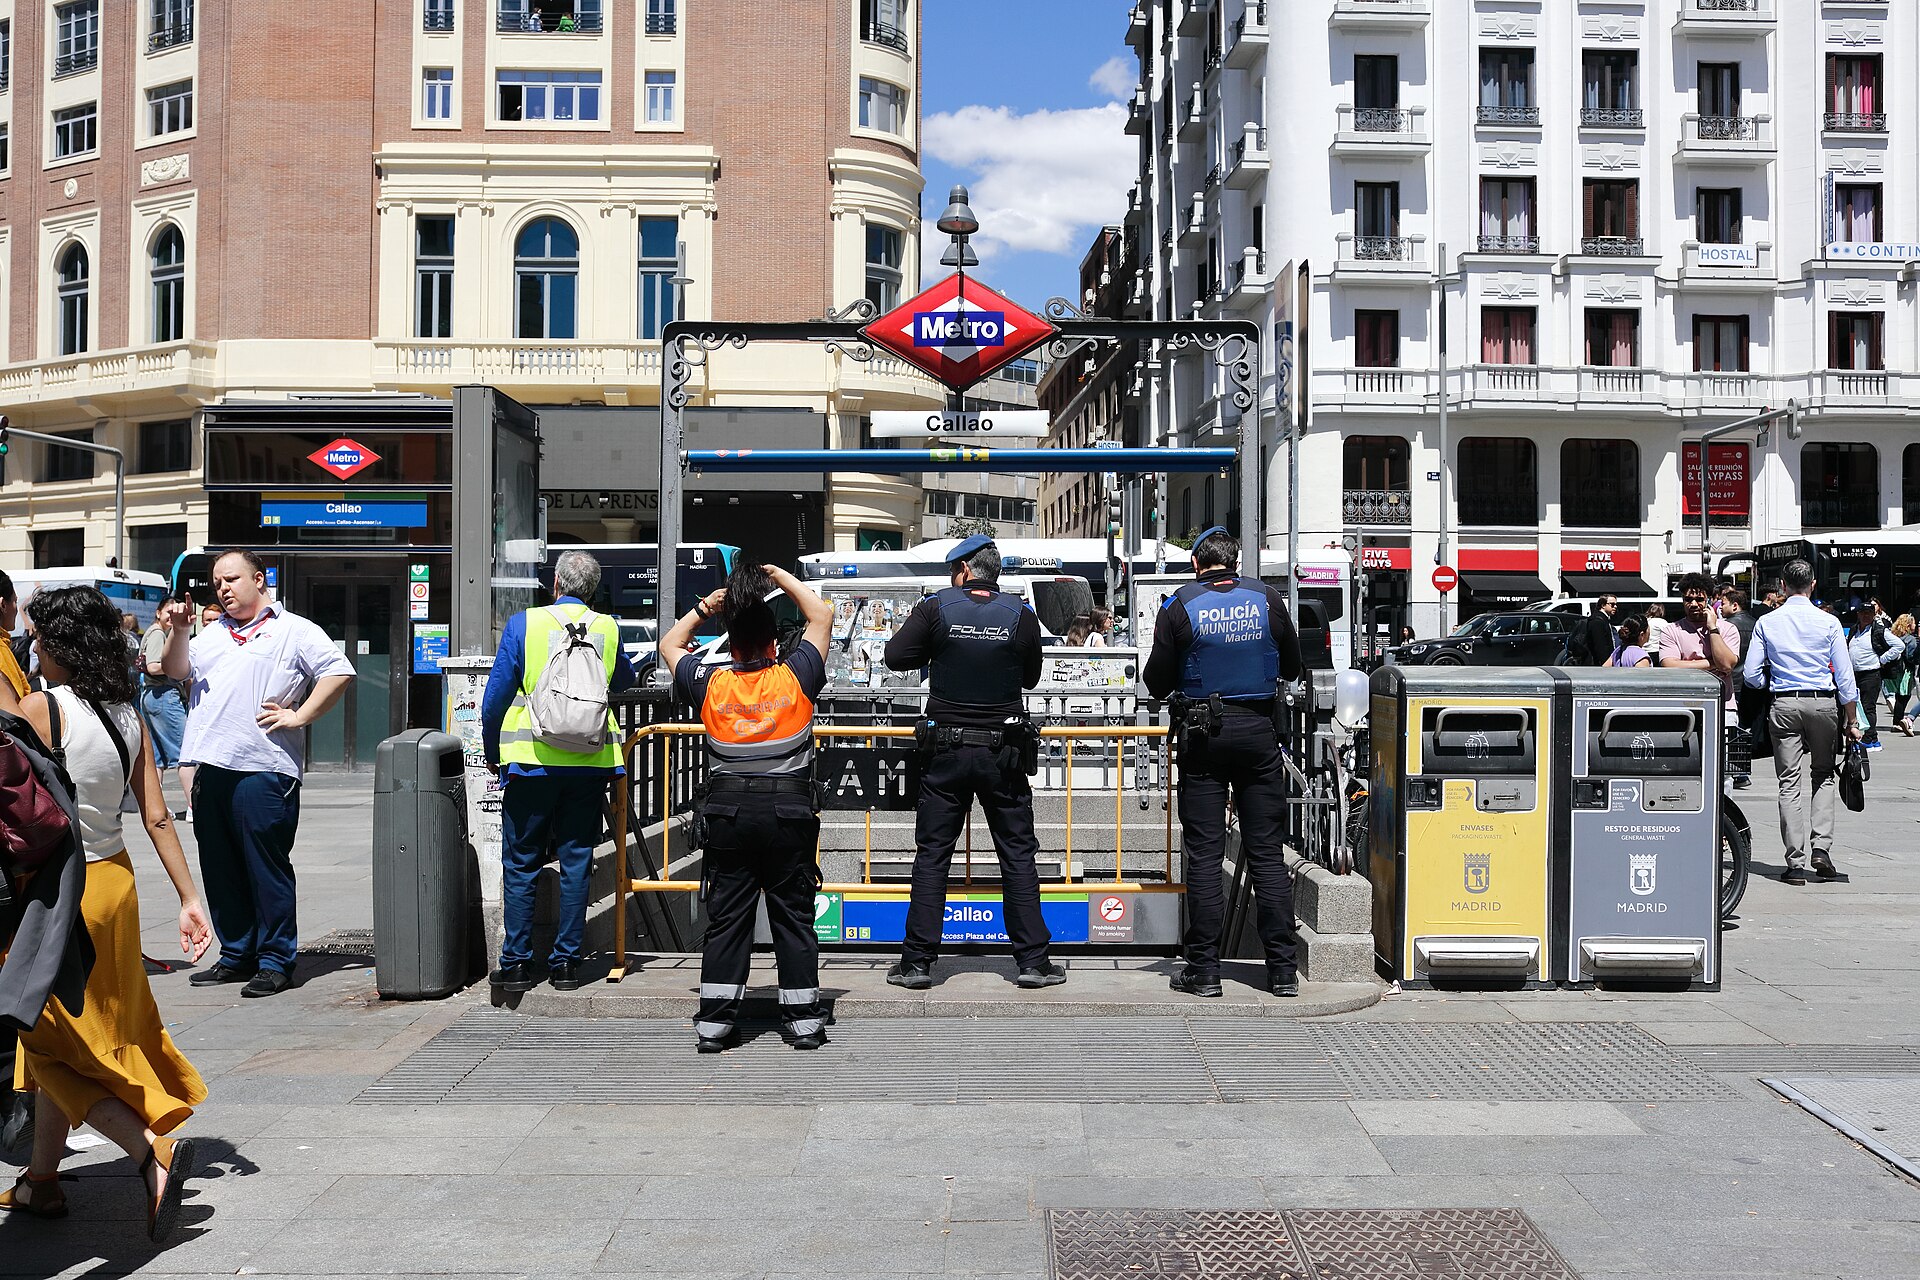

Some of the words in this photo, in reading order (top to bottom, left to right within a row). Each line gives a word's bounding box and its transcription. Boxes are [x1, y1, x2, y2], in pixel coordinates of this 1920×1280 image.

[1701, 249, 1753, 261] HOSTAL
[921, 317, 998, 339] Metro
[926, 415, 994, 431] Callao
[330, 453, 359, 463] Metro
[1714, 462, 1743, 471] REUNIÓN
[1687, 472, 1694, 480] &
[570, 494, 594, 509] LA
[326, 503, 362, 513] Callao
[1364, 550, 1389, 558] FIVE
[1587, 553, 1612, 561] FIVE
[1763, 546, 1770, 560] 74
[1022, 557, 1057, 566] POLICIA
[1362, 559, 1392, 567] GUYS
[1585, 561, 1615, 571] GUYS
[1307, 571, 1334, 579] MADRID
[1198, 601, 1260, 623] POLICÍA
[1199, 618, 1262, 636] MUNICIPAL
[1225, 631, 1262, 643] Madrid
[714, 695, 791, 715] SEGURIDAD
[836, 759, 906, 796] AM
[1604, 825, 1629, 833] RESTO
[1630, 825, 1641, 833] DE
[1642, 825, 1681, 833] RESIDUOS
[1451, 901, 1502, 911] MADRID
[1617, 902, 1668, 913] MADRID
[942, 906, 994, 922] Callao
[848, 928, 855, 938] 3
[862, 928, 869, 938] 5
[965, 932, 985, 940] Plaza
[985, 932, 997, 940] del
